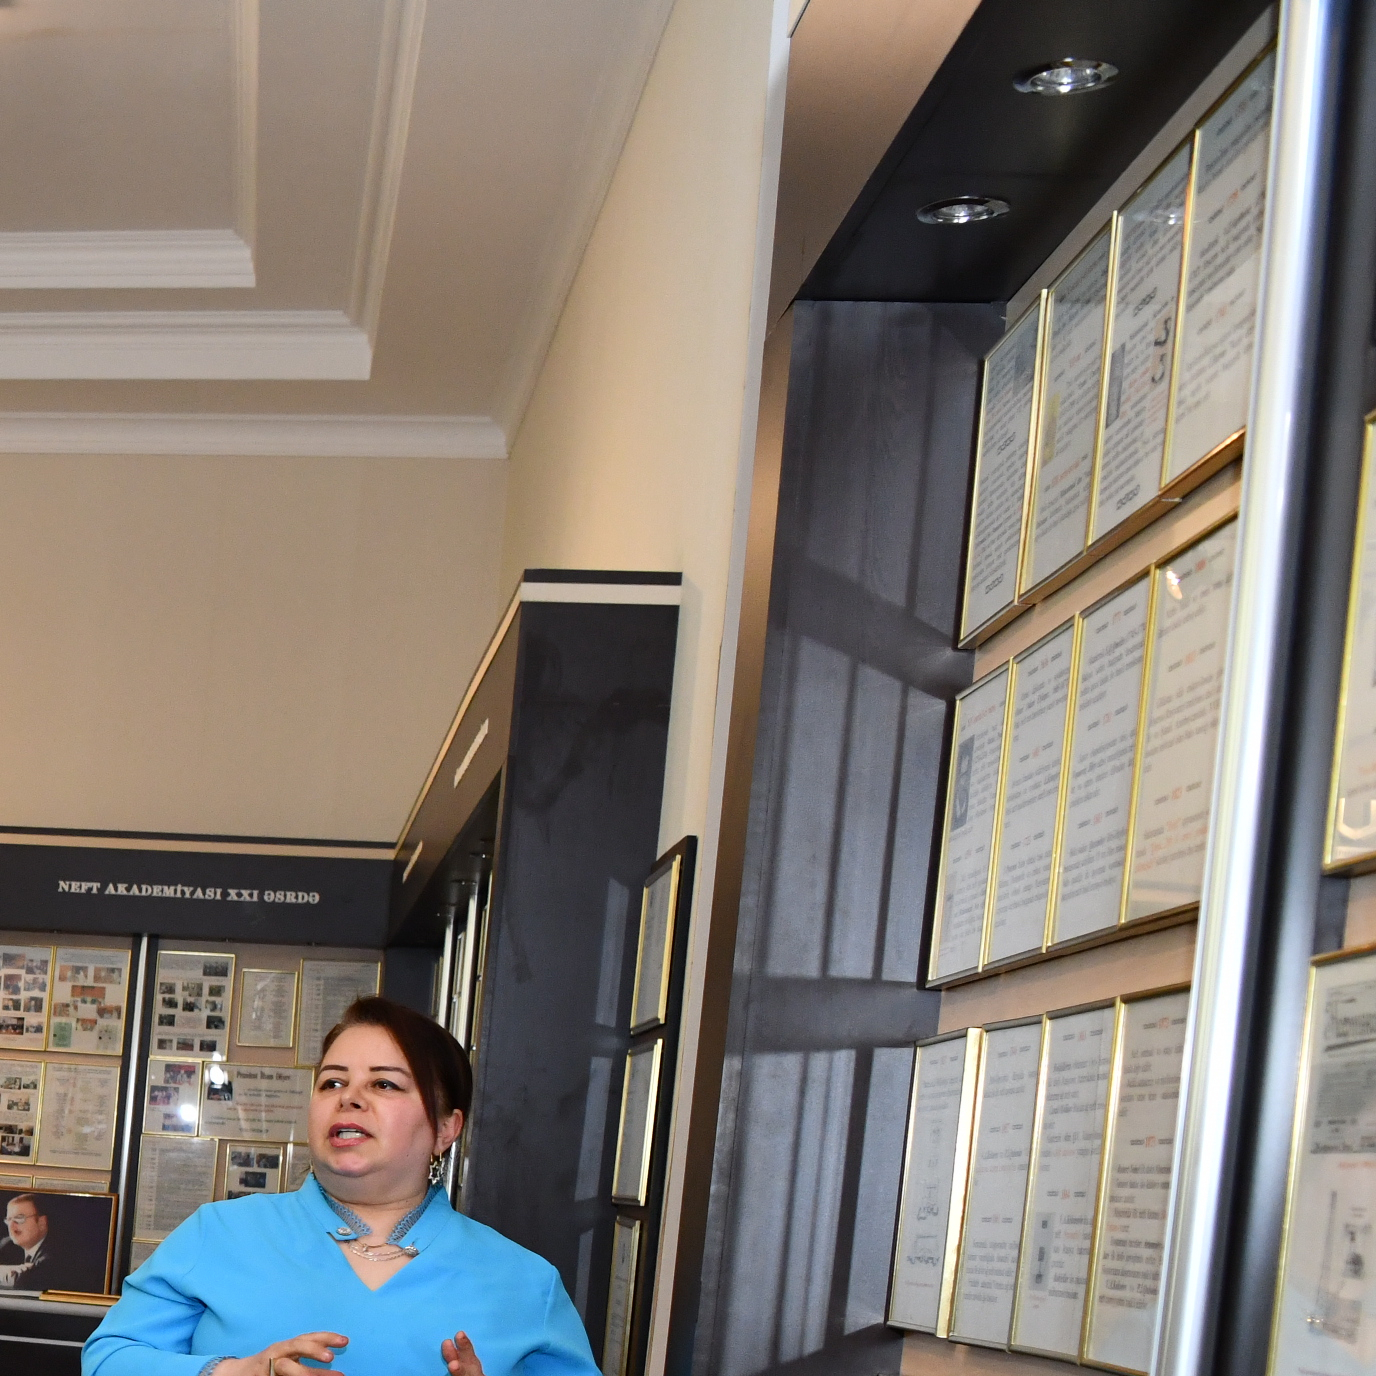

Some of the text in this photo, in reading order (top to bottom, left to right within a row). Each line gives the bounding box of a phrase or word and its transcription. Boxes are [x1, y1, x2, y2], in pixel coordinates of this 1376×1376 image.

[58, 881, 320, 904] NEFT AKADEMİYASI XXI ƏSRDƏ
